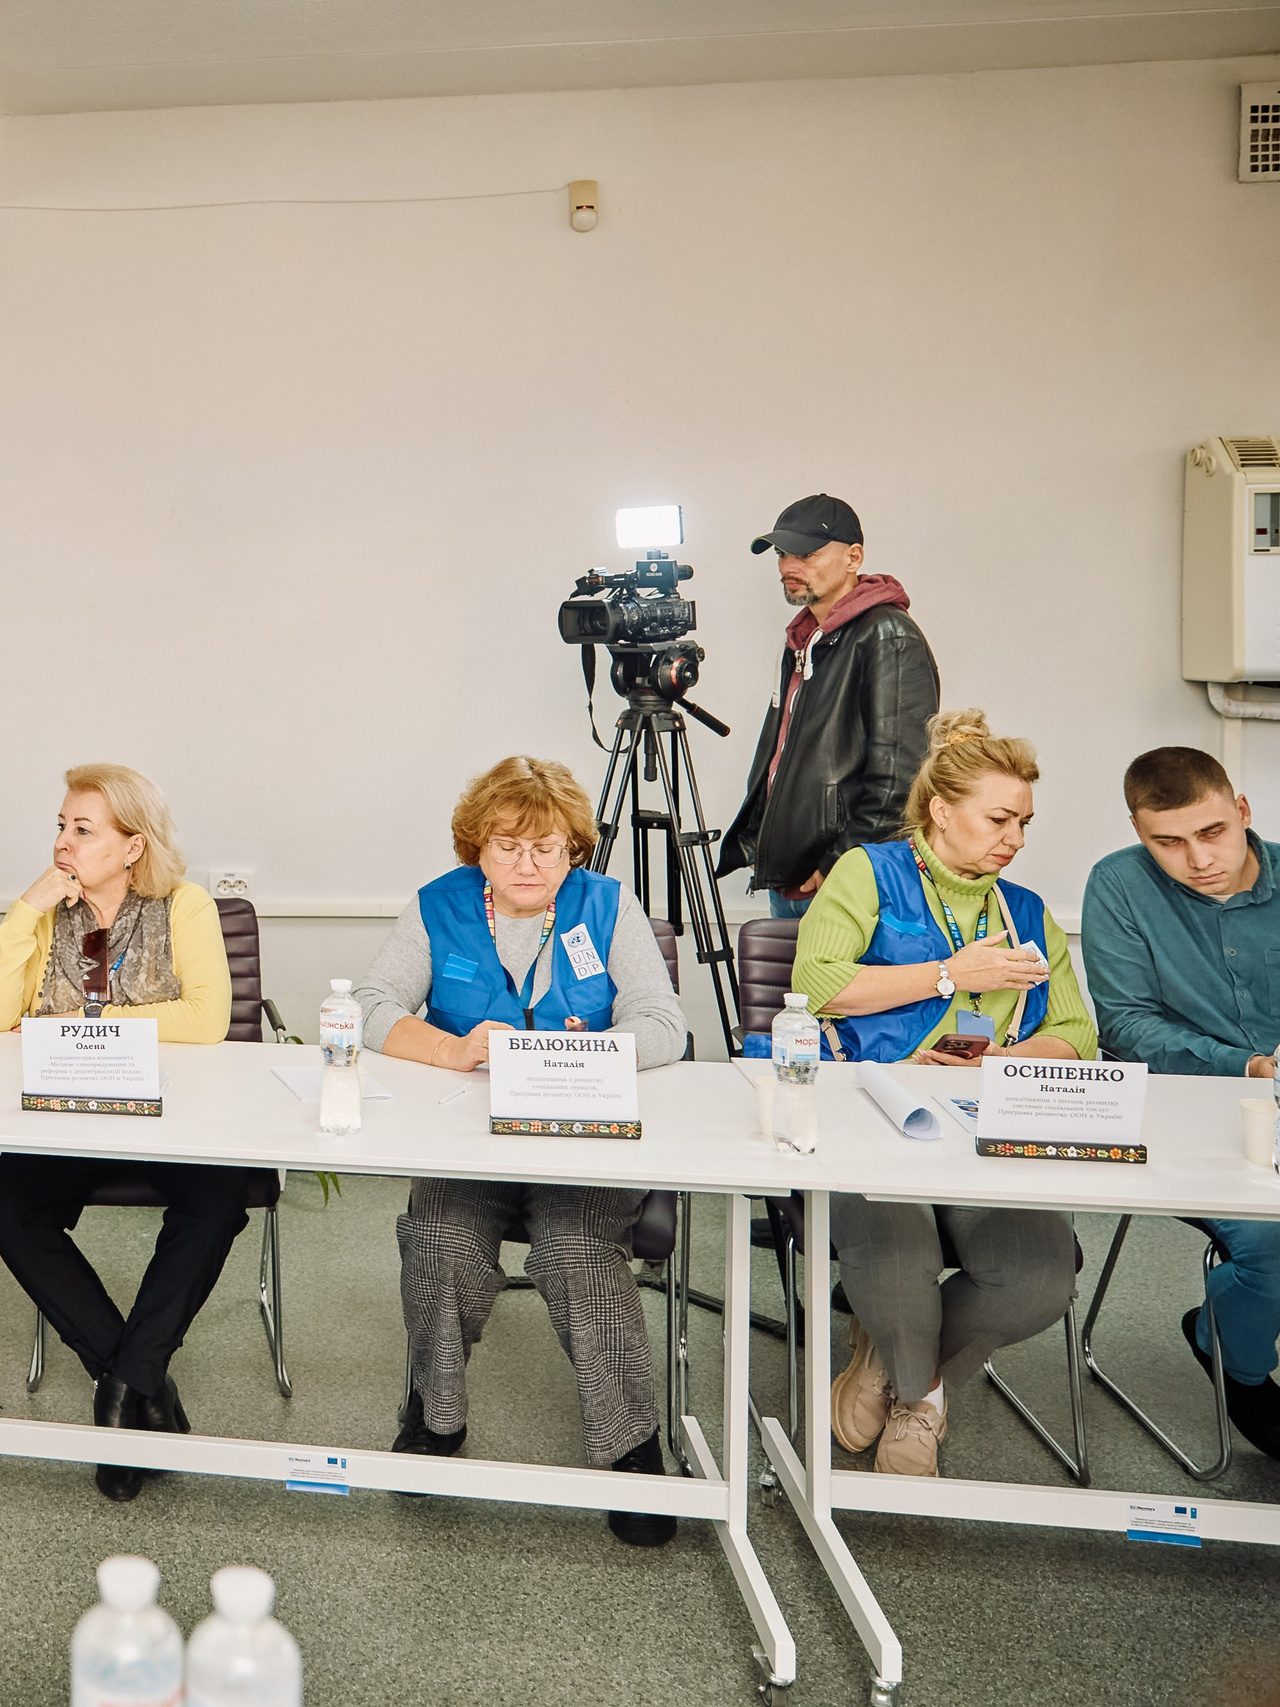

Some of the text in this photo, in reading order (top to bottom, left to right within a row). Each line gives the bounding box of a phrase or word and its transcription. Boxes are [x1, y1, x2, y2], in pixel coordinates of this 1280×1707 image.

[60, 1025, 121, 1039] РУДИЧ
[76, 1042, 106, 1050] Олена
[508, 1037, 619, 1052] БЕЛЮКИНА
[543, 1059, 585, 1068] Наталія
[1003, 1064, 1125, 1082] ОСИПЕНКО
[1039, 1084, 1086, 1094] Наталія
[997, 1108, 1033, 1116] Програма
[1034, 1110, 1069, 1118] розвитку
